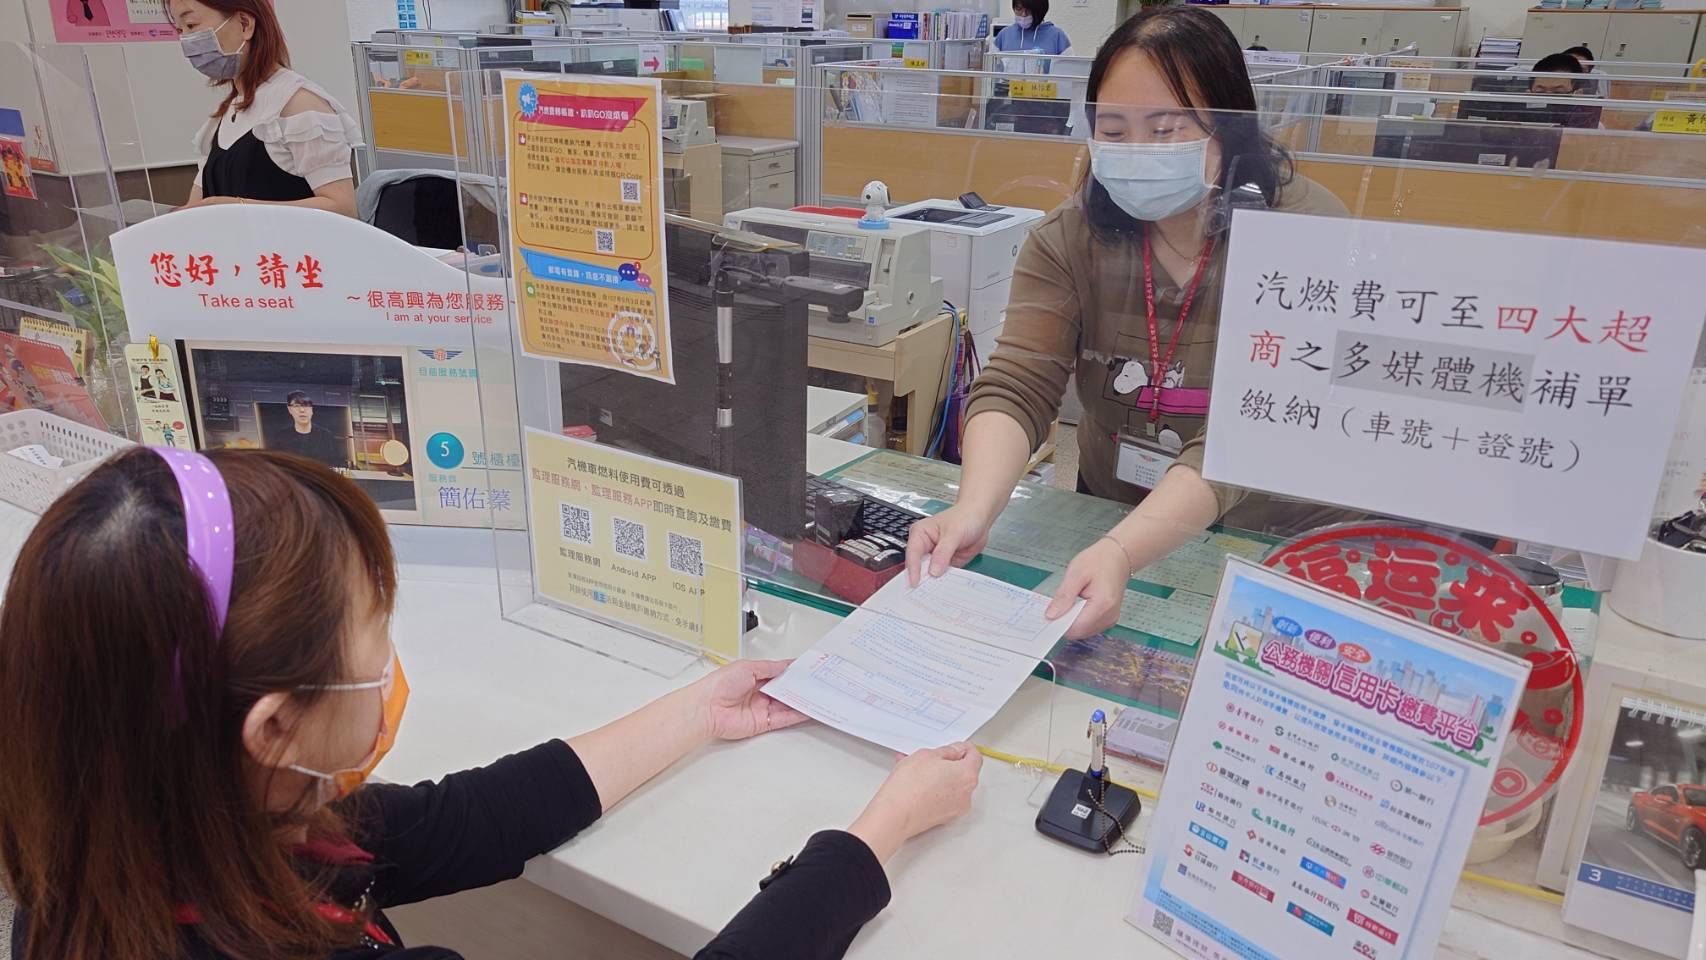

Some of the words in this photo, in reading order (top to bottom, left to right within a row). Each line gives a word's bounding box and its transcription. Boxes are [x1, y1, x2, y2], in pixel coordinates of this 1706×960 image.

[150, 252, 324, 289] 您好，請坐
[200, 293, 241, 309] Take
[244, 298, 254, 309] a
[258, 294, 295, 310] seat
[386, 313, 390, 322] I
[393, 315, 410, 323] am
[414, 314, 424, 323] at
[427, 315, 450, 325] your
[454, 313, 493, 324] service
[1255, 271, 1652, 354] 汽燃費可至四大超
[75, 339, 83, 354] 2
[1249, 330, 1634, 417] 商之多媒體機補單
[440, 441, 450, 457] 5
[567, 457, 685, 498] 汽機車燃料使用費可透過
[559, 546, 601, 568] 監理服務網
[611, 563, 639, 578] Android
[642, 571, 657, 582] APP
[1308, 630, 1333, 648] 便利
[1341, 644, 1370, 662] 安全
[1262, 639, 1478, 750] 公務機關信用卡繳費平台
[1588, 868, 1602, 882] 3
